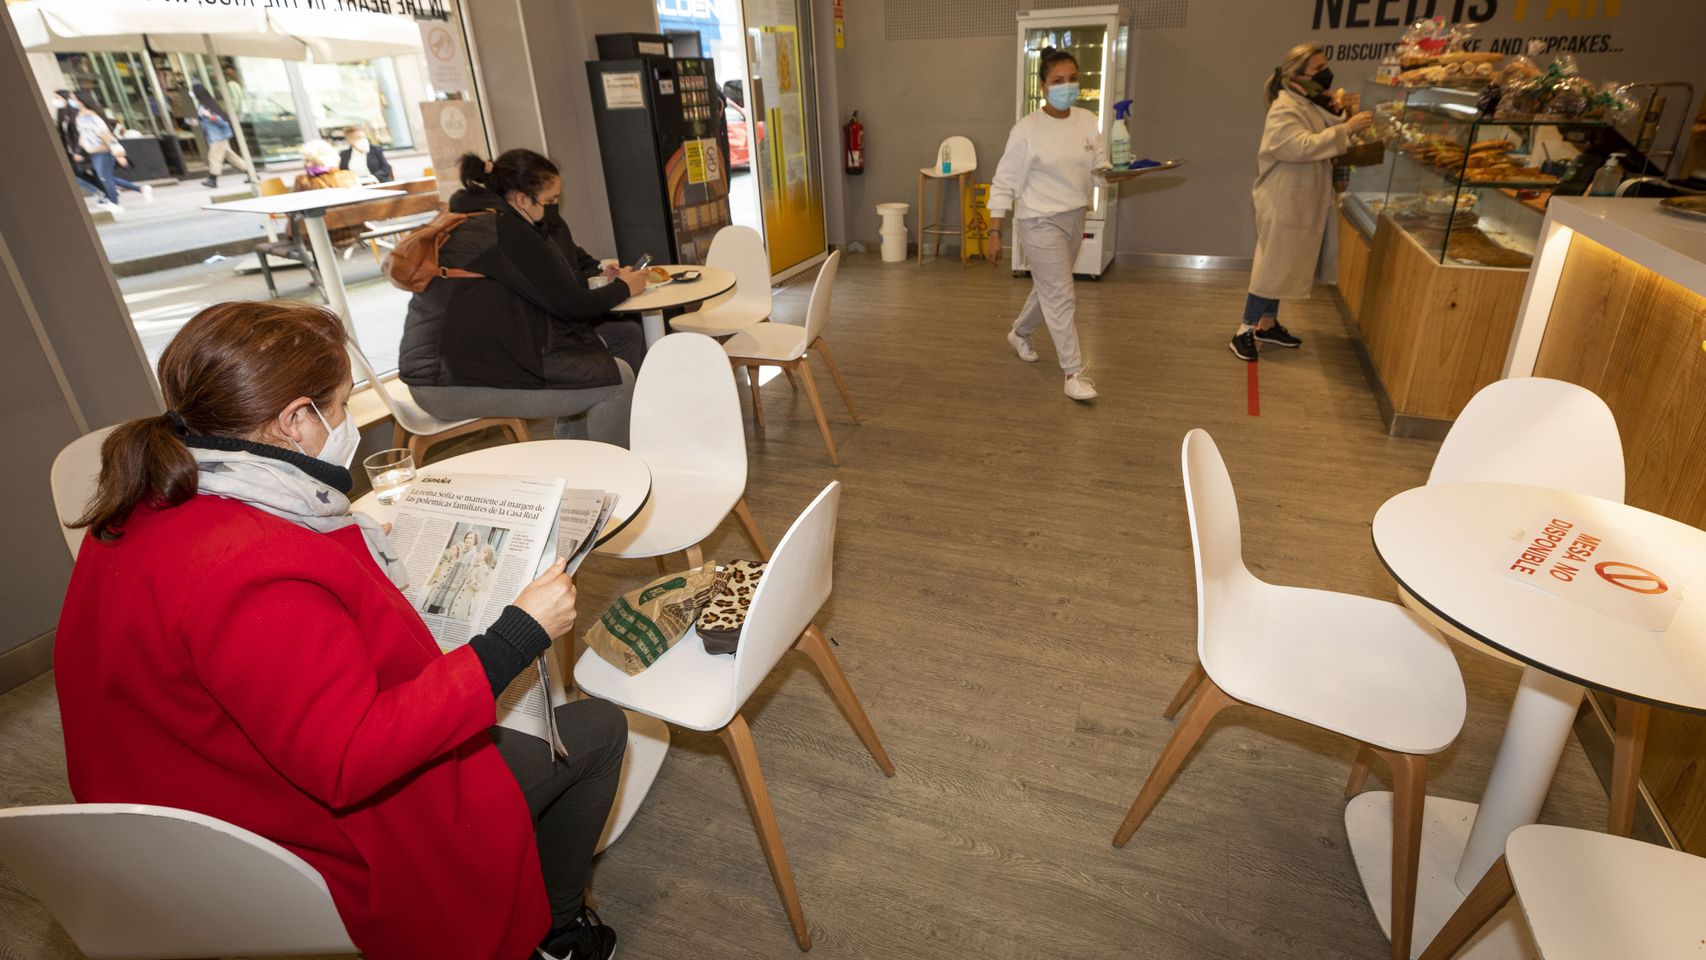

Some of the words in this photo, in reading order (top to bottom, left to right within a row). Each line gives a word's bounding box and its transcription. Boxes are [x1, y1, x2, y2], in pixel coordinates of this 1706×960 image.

[1490, 37, 1523, 56] AND
[405, 495, 416, 503] las
[452, 501, 487, 513] familiares
[488, 506, 498, 514] de
[498, 507, 506, 515] la
[506, 509, 522, 518] Casa
[523, 511, 540, 520] Real
[410, 488, 419, 496] La
[418, 489, 437, 497] reina
[464, 495, 498, 506] mantiene
[499, 499, 507, 507] al
[507, 501, 534, 512] margen
[535, 504, 545, 512] de
[1510, 518, 1574, 576] DISPONIBLE
[1562, 533, 1602, 563] MESA
[1549, 561, 1579, 583] NO
